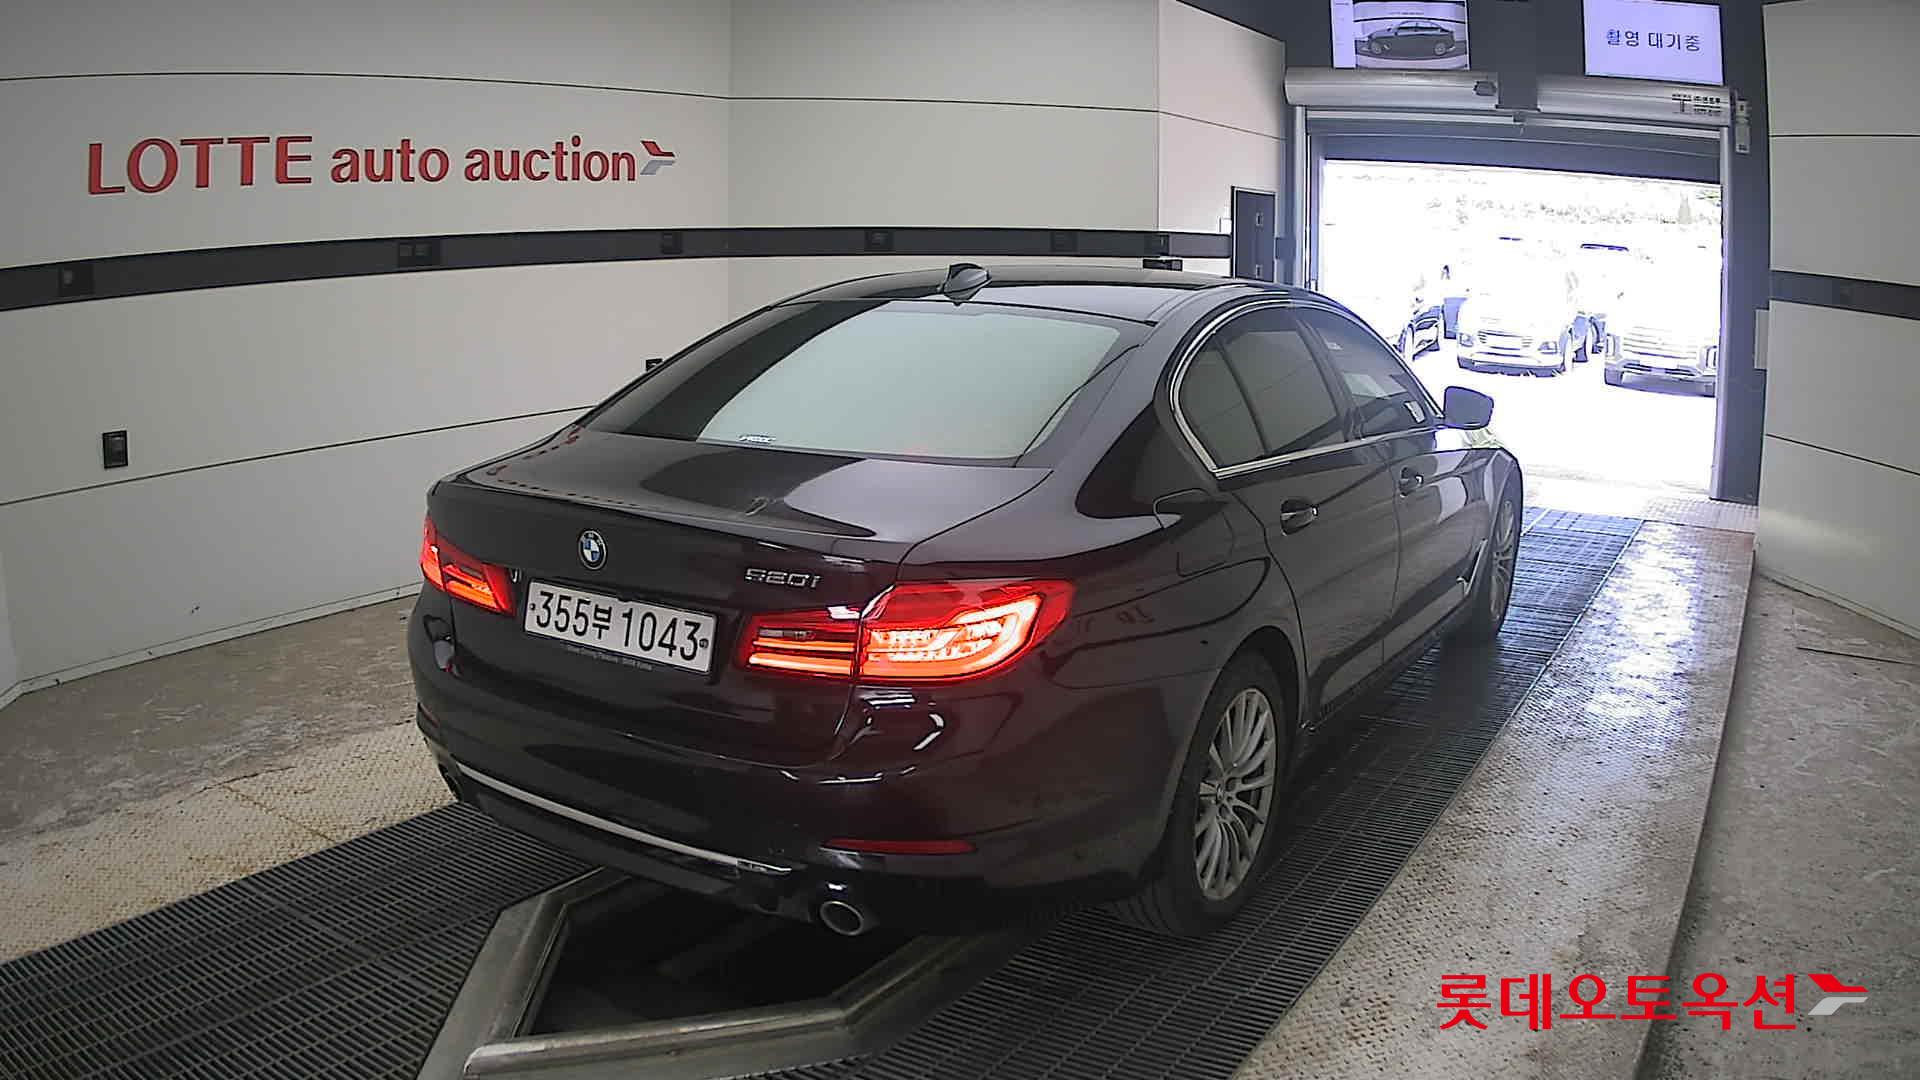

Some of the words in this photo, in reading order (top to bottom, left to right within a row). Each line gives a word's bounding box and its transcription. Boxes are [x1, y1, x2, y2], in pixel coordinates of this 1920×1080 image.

[1648, 32, 1701, 52] 대기중
[88, 136, 312, 195] LOTTE
[331, 138, 449, 183] auto
[464, 135, 637, 183] auction
[622, 607, 701, 661] 1043
